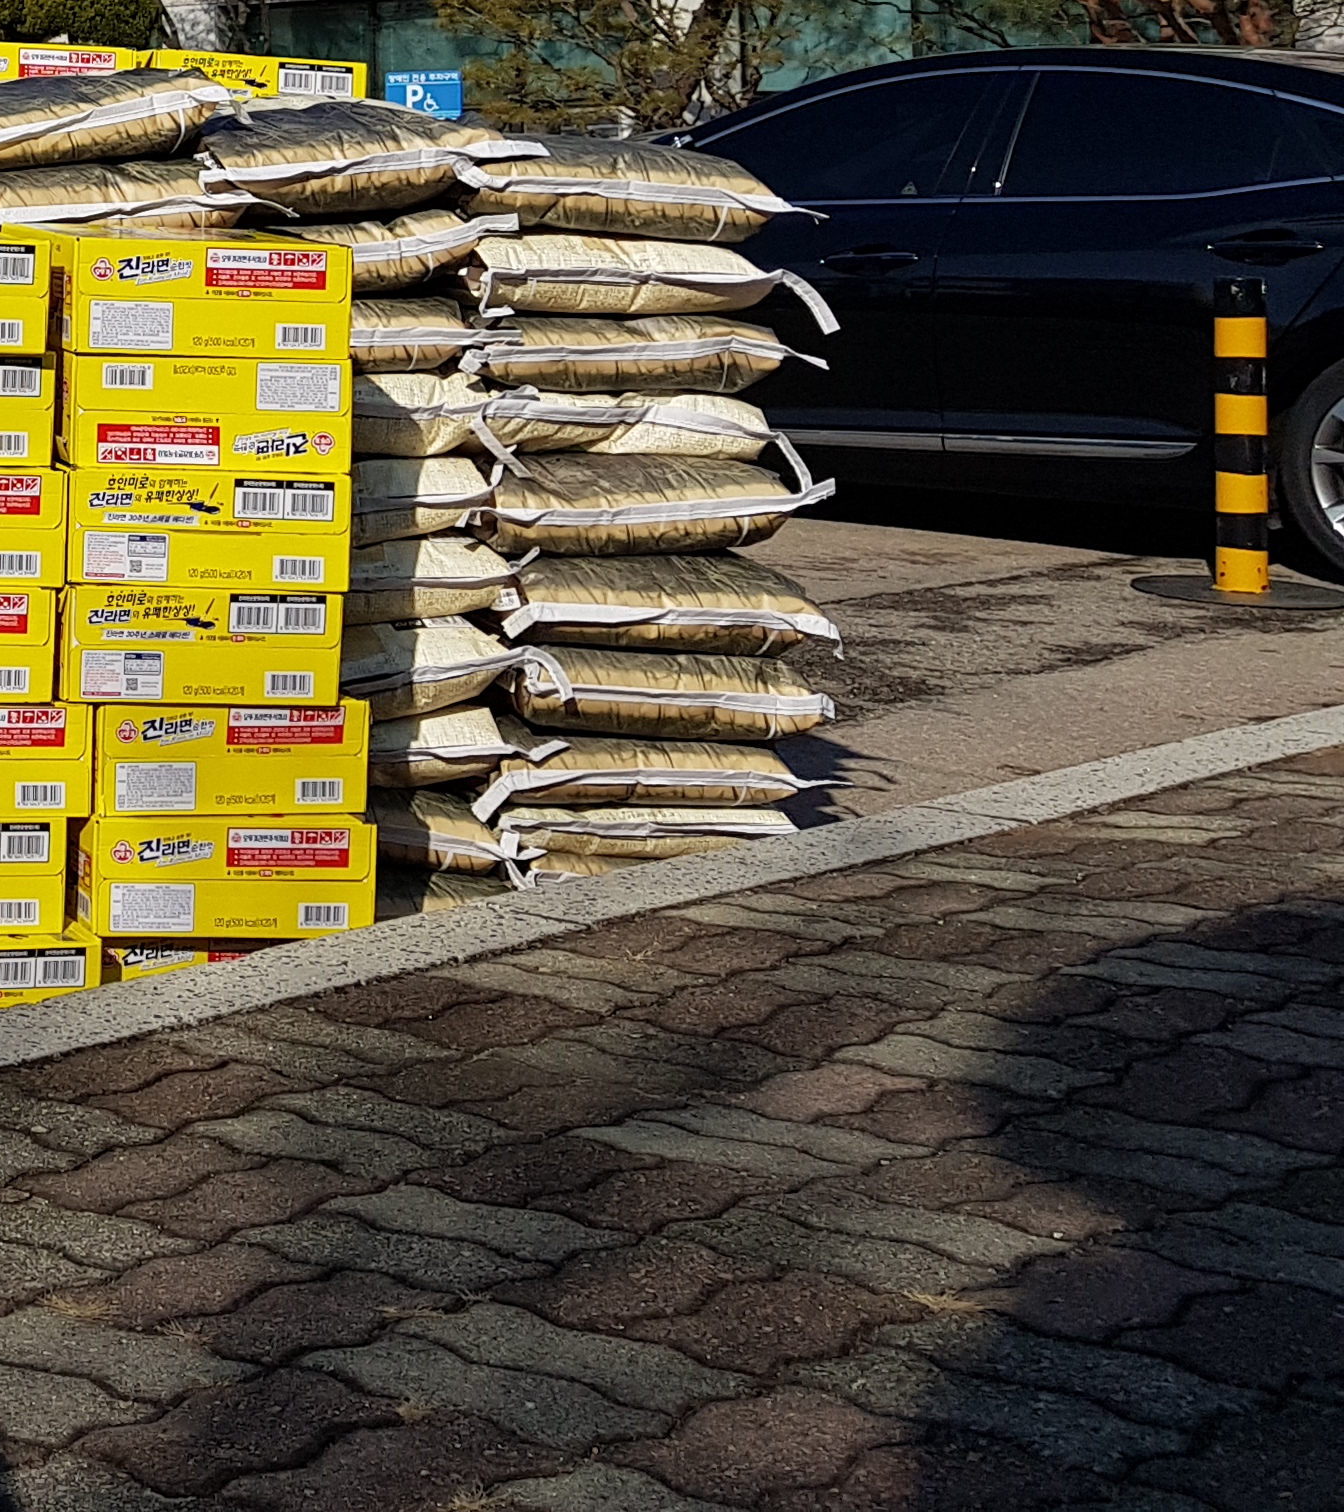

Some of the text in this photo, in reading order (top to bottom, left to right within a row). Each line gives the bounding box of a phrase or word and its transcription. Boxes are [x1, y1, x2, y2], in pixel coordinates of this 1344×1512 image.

[406, 85, 424, 108] P
[117, 256, 170, 279] 진라면
[141, 717, 193, 740] 진라면
[137, 837, 191, 861] 진라면
